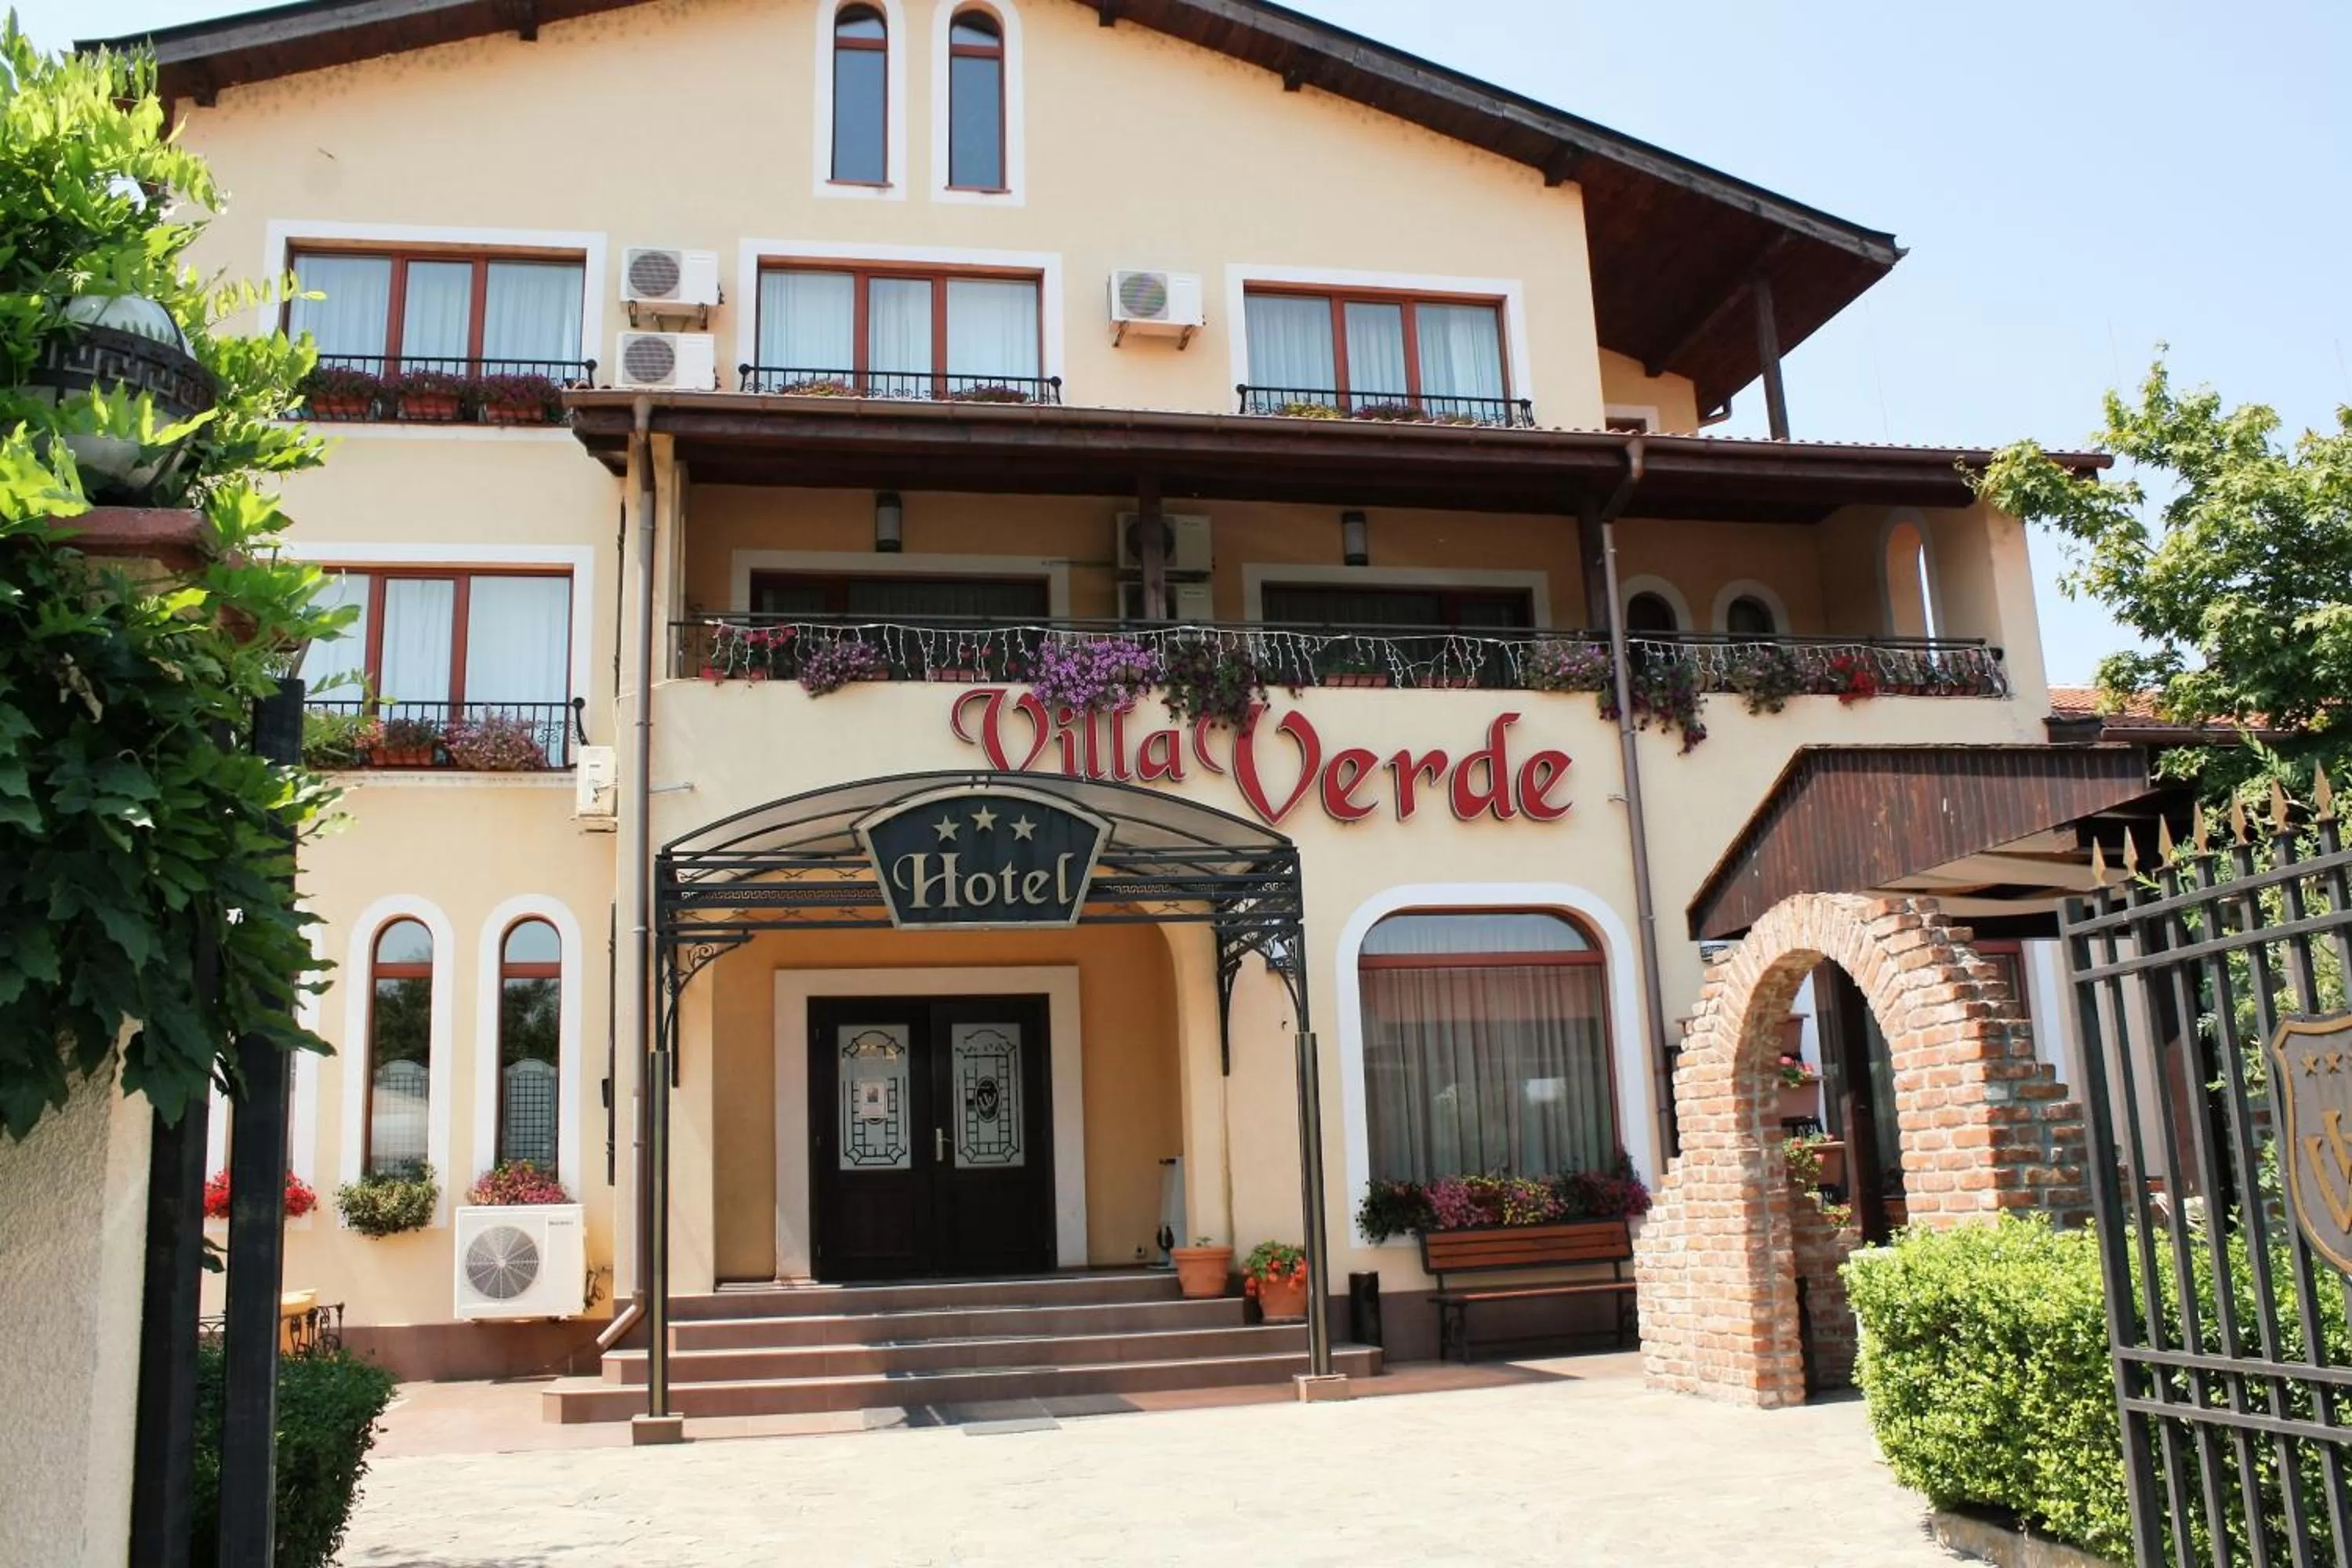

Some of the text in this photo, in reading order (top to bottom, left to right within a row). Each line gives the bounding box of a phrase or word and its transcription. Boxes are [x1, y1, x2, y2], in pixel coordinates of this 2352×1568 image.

[951, 688, 1573, 826] Villa Verde
[893, 852, 1075, 909] Hotel
